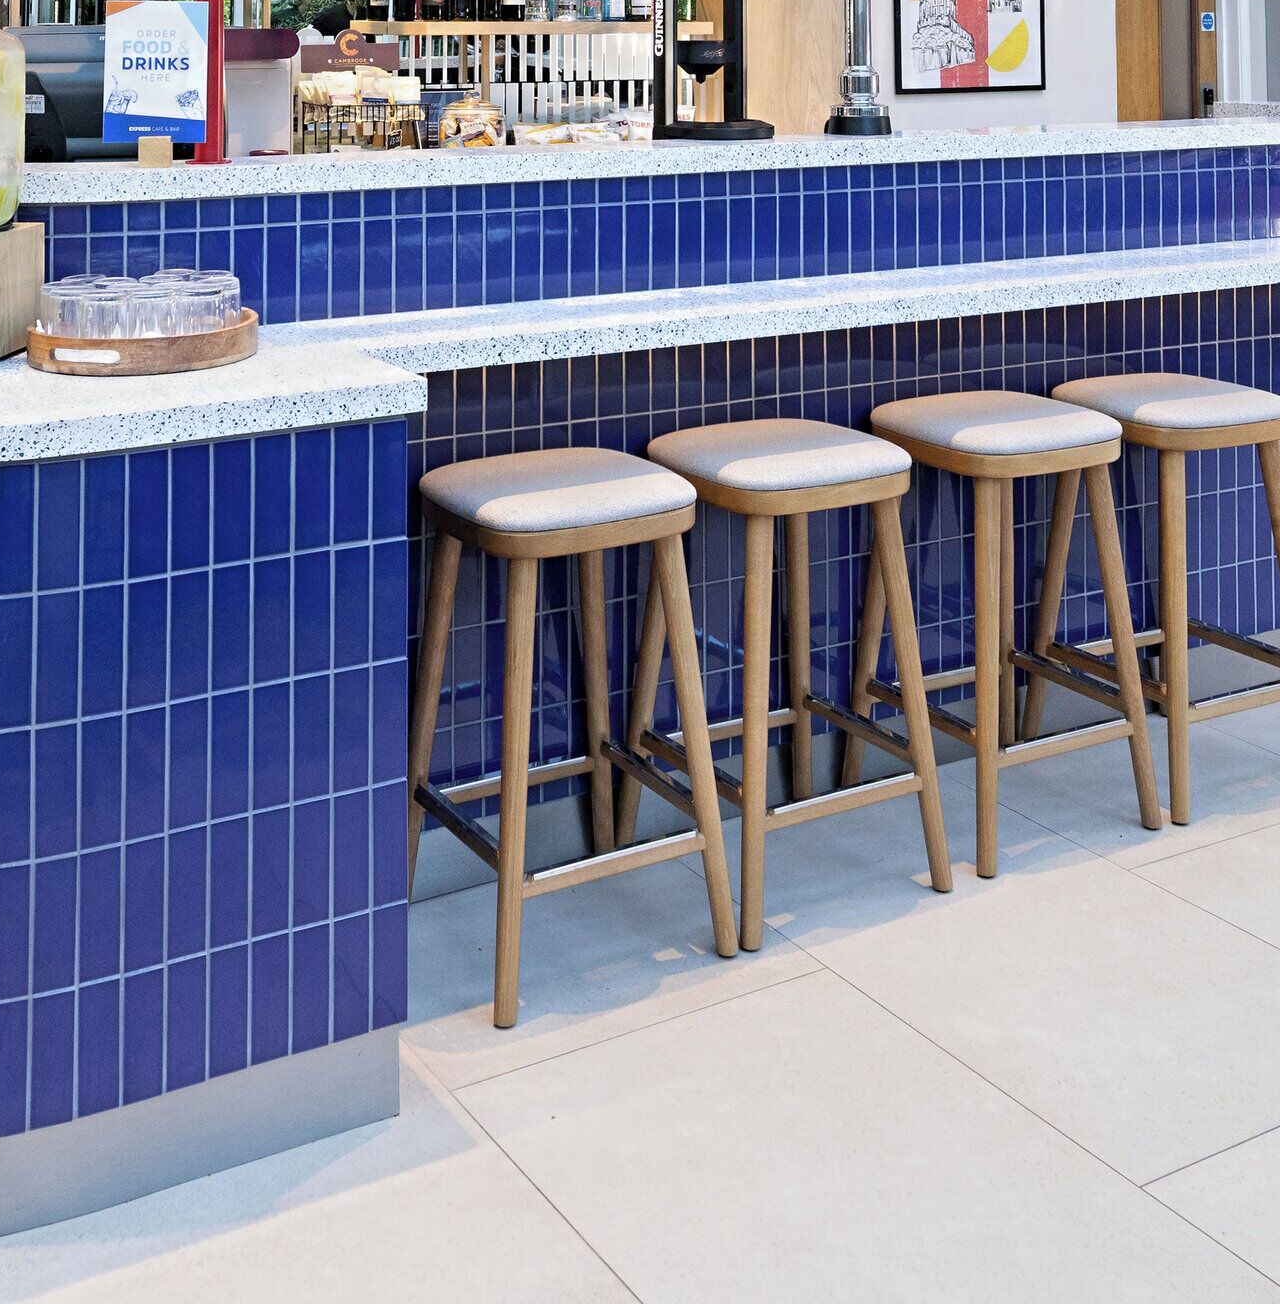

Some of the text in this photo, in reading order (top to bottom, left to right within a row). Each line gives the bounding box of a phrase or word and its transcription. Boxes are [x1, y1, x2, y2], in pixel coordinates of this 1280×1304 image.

[137, 29, 177, 38] ORDER
[122, 40, 190, 55] FOOD &
[122, 57, 190, 71] DRINKS
